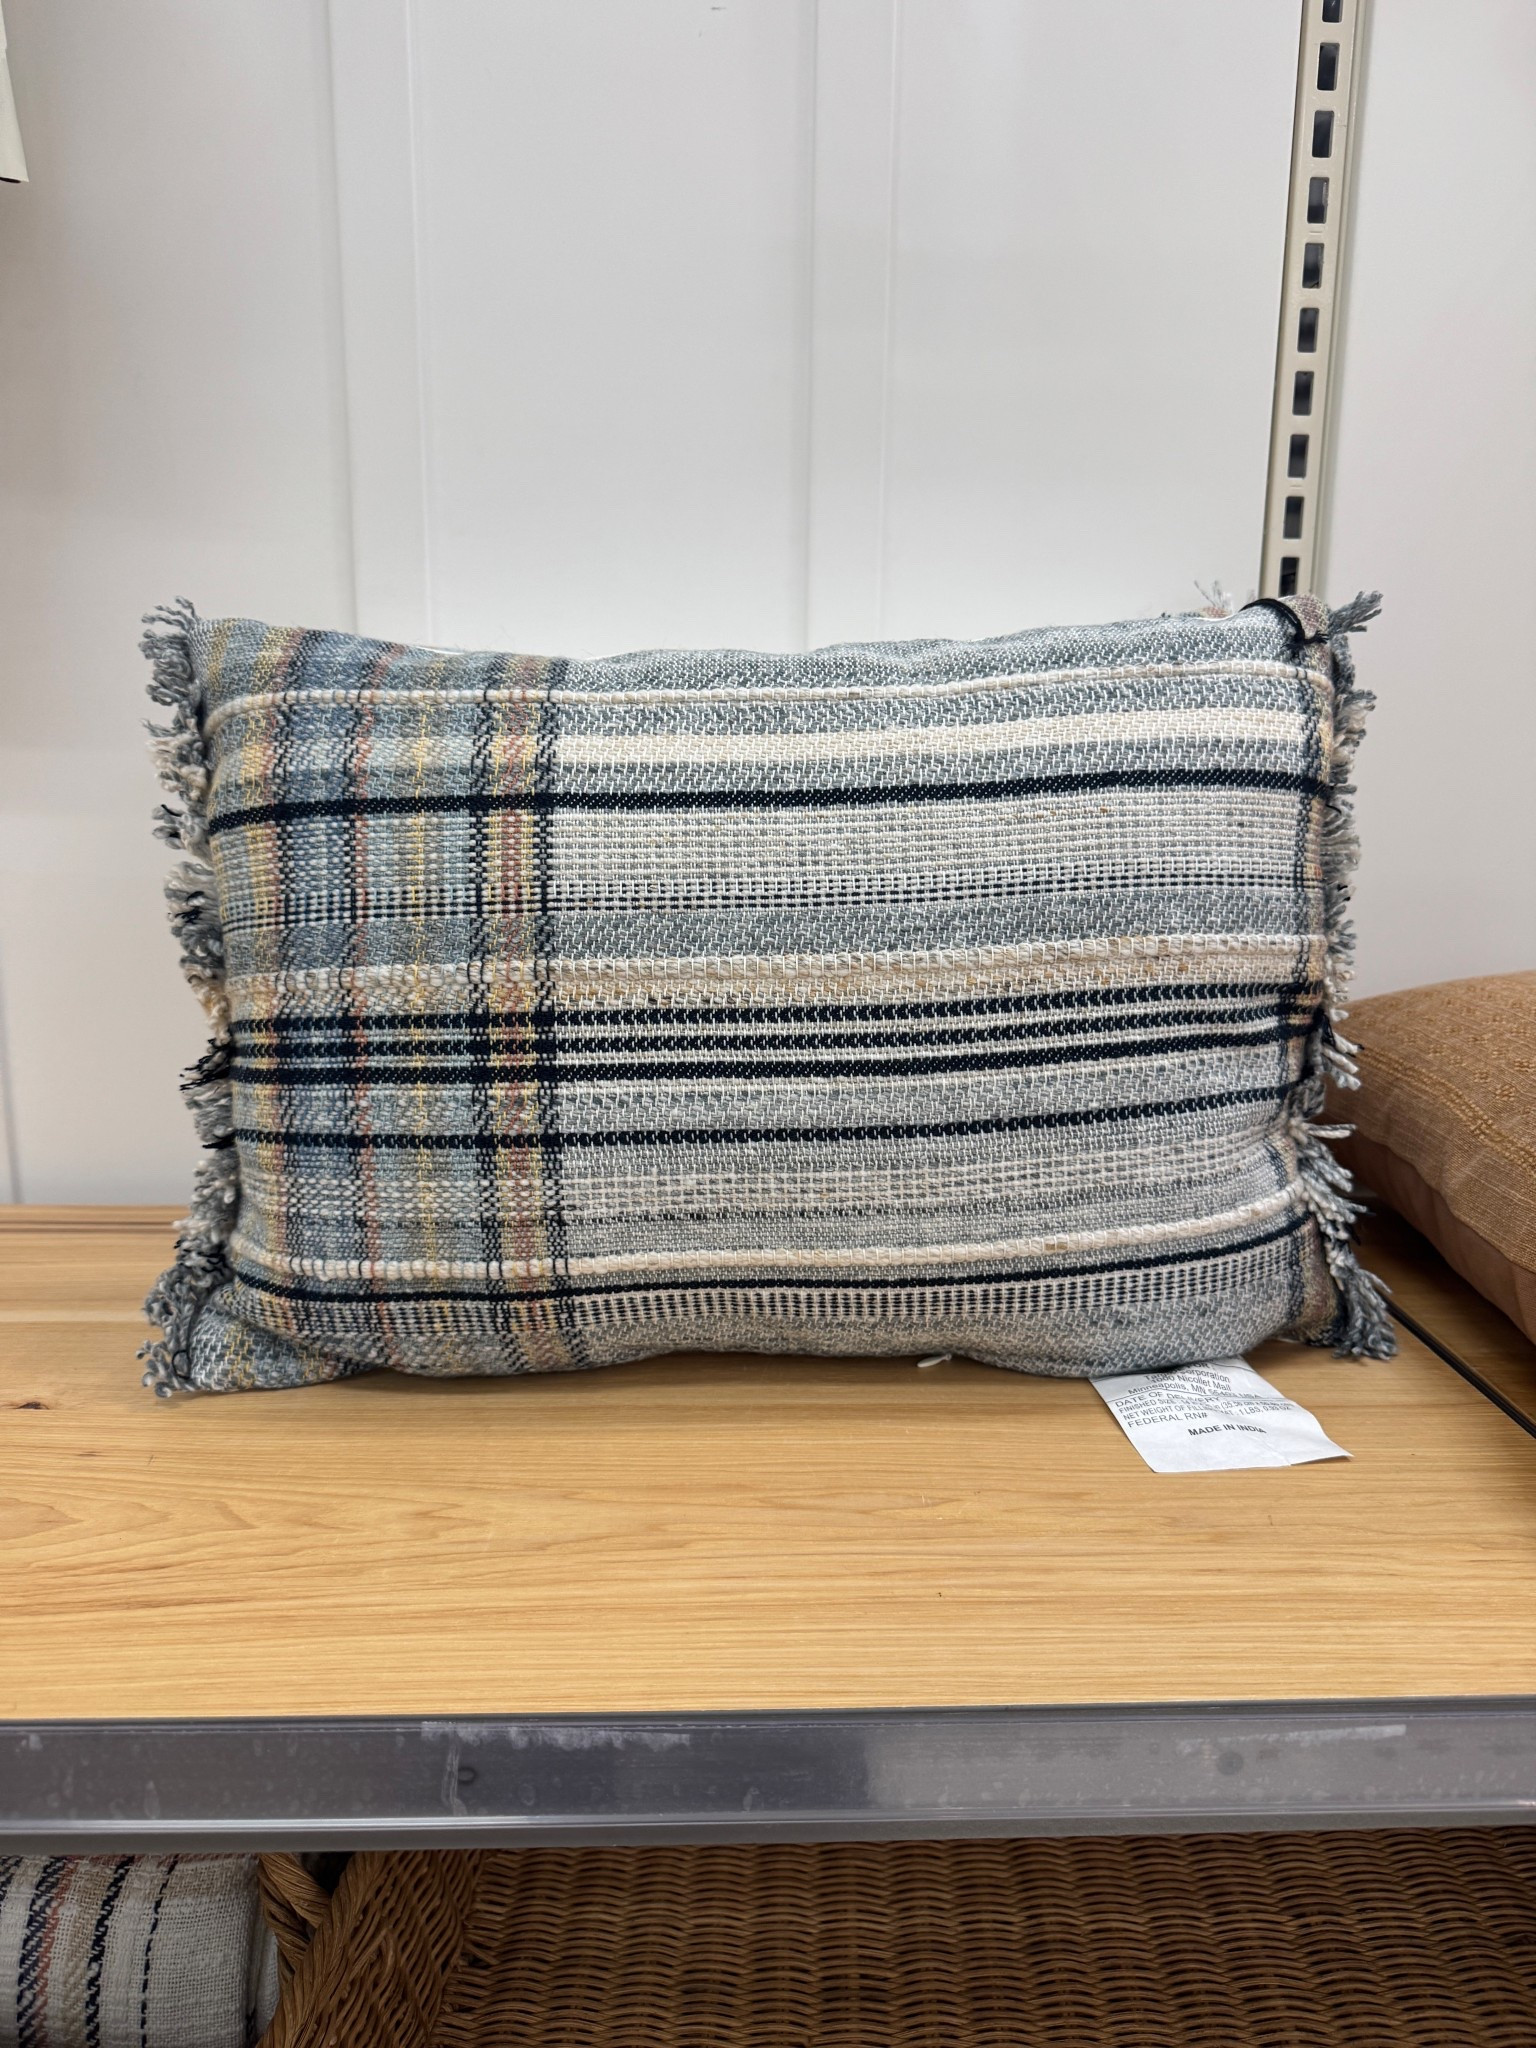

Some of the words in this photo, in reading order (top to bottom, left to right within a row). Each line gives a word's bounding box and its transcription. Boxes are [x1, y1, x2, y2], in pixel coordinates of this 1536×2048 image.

[1177, 1374, 1211, 1388] Nicollet
[1213, 1380, 1232, 1392] Mall
[1191, 1383, 1207, 1395] MN
[1115, 1394, 1147, 1407] DATE
[1148, 1391, 1163, 1399] OF
[1119, 1399, 1157, 1414] FINISHED
[1123, 1411, 1140, 1421] NET
[1140, 1405, 1174, 1417] WEIGHT
[1174, 1403, 1186, 1412] OF
[1127, 1414, 1184, 1428] FEDERAL
[1184, 1411, 1208, 1421] RN#
[1187, 1424, 1222, 1436] MADE
[1223, 1423, 1236, 1431] IN
[1236, 1424, 1267, 1434] INDIA
